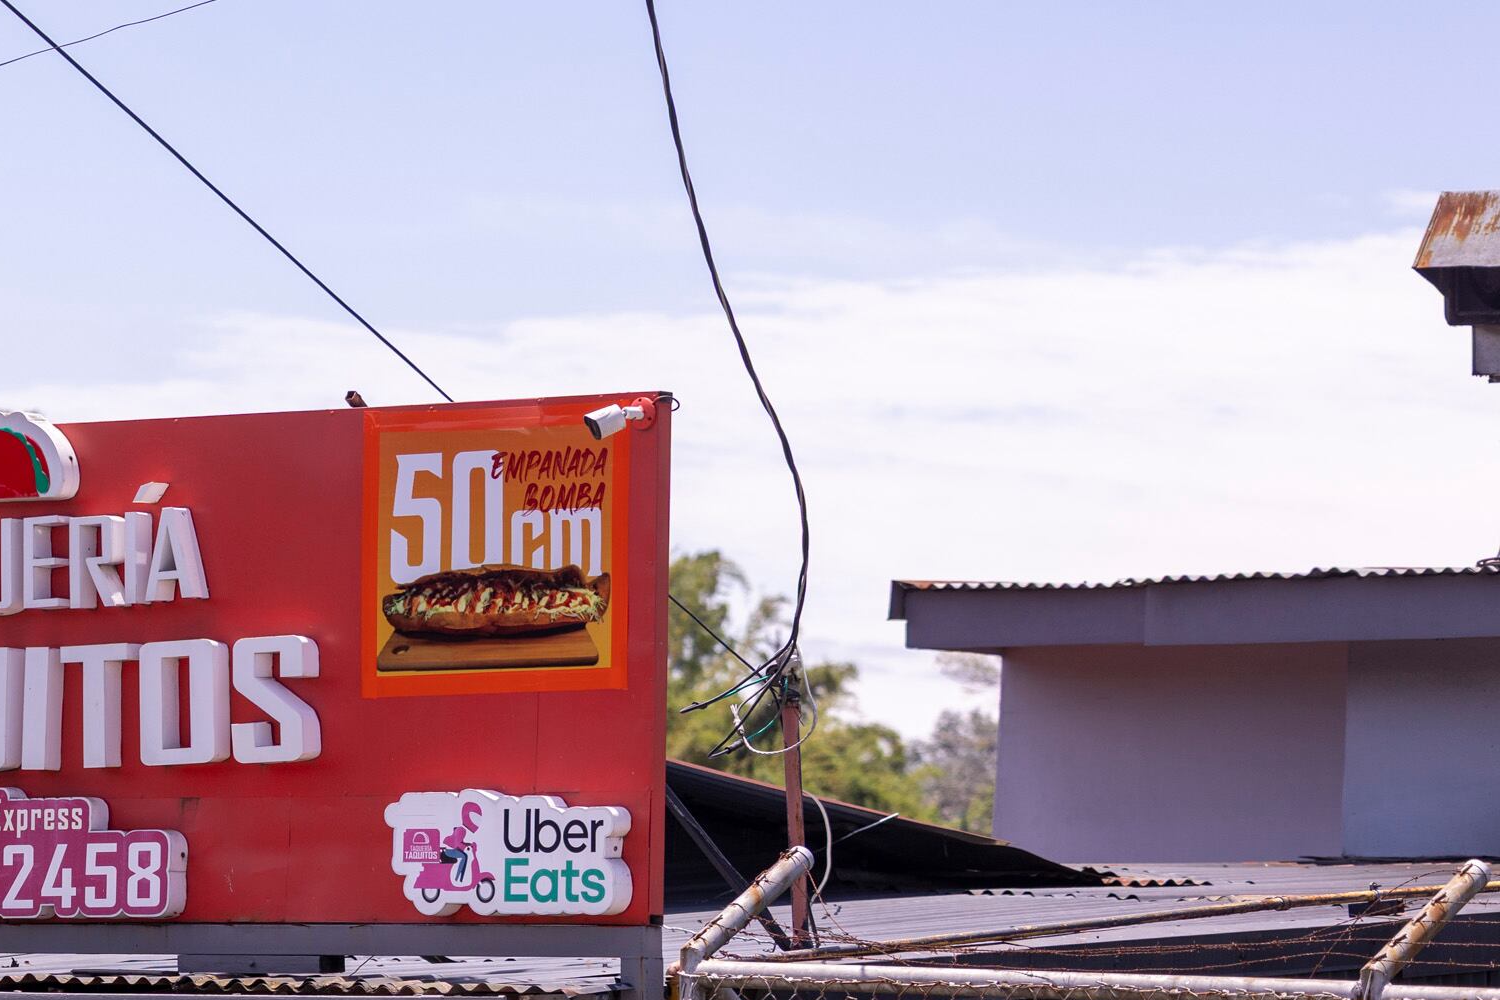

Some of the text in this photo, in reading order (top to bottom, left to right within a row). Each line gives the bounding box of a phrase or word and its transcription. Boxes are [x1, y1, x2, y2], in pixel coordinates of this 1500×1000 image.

[491, 446, 608, 483] EMPANADA
[390, 450, 603, 584] 50cm
[521, 482, 606, 516] BOMBA
[503, 808, 604, 854] Uber
[405, 851, 438, 859] TAQUITOS
[503, 858, 606, 903] Eats
